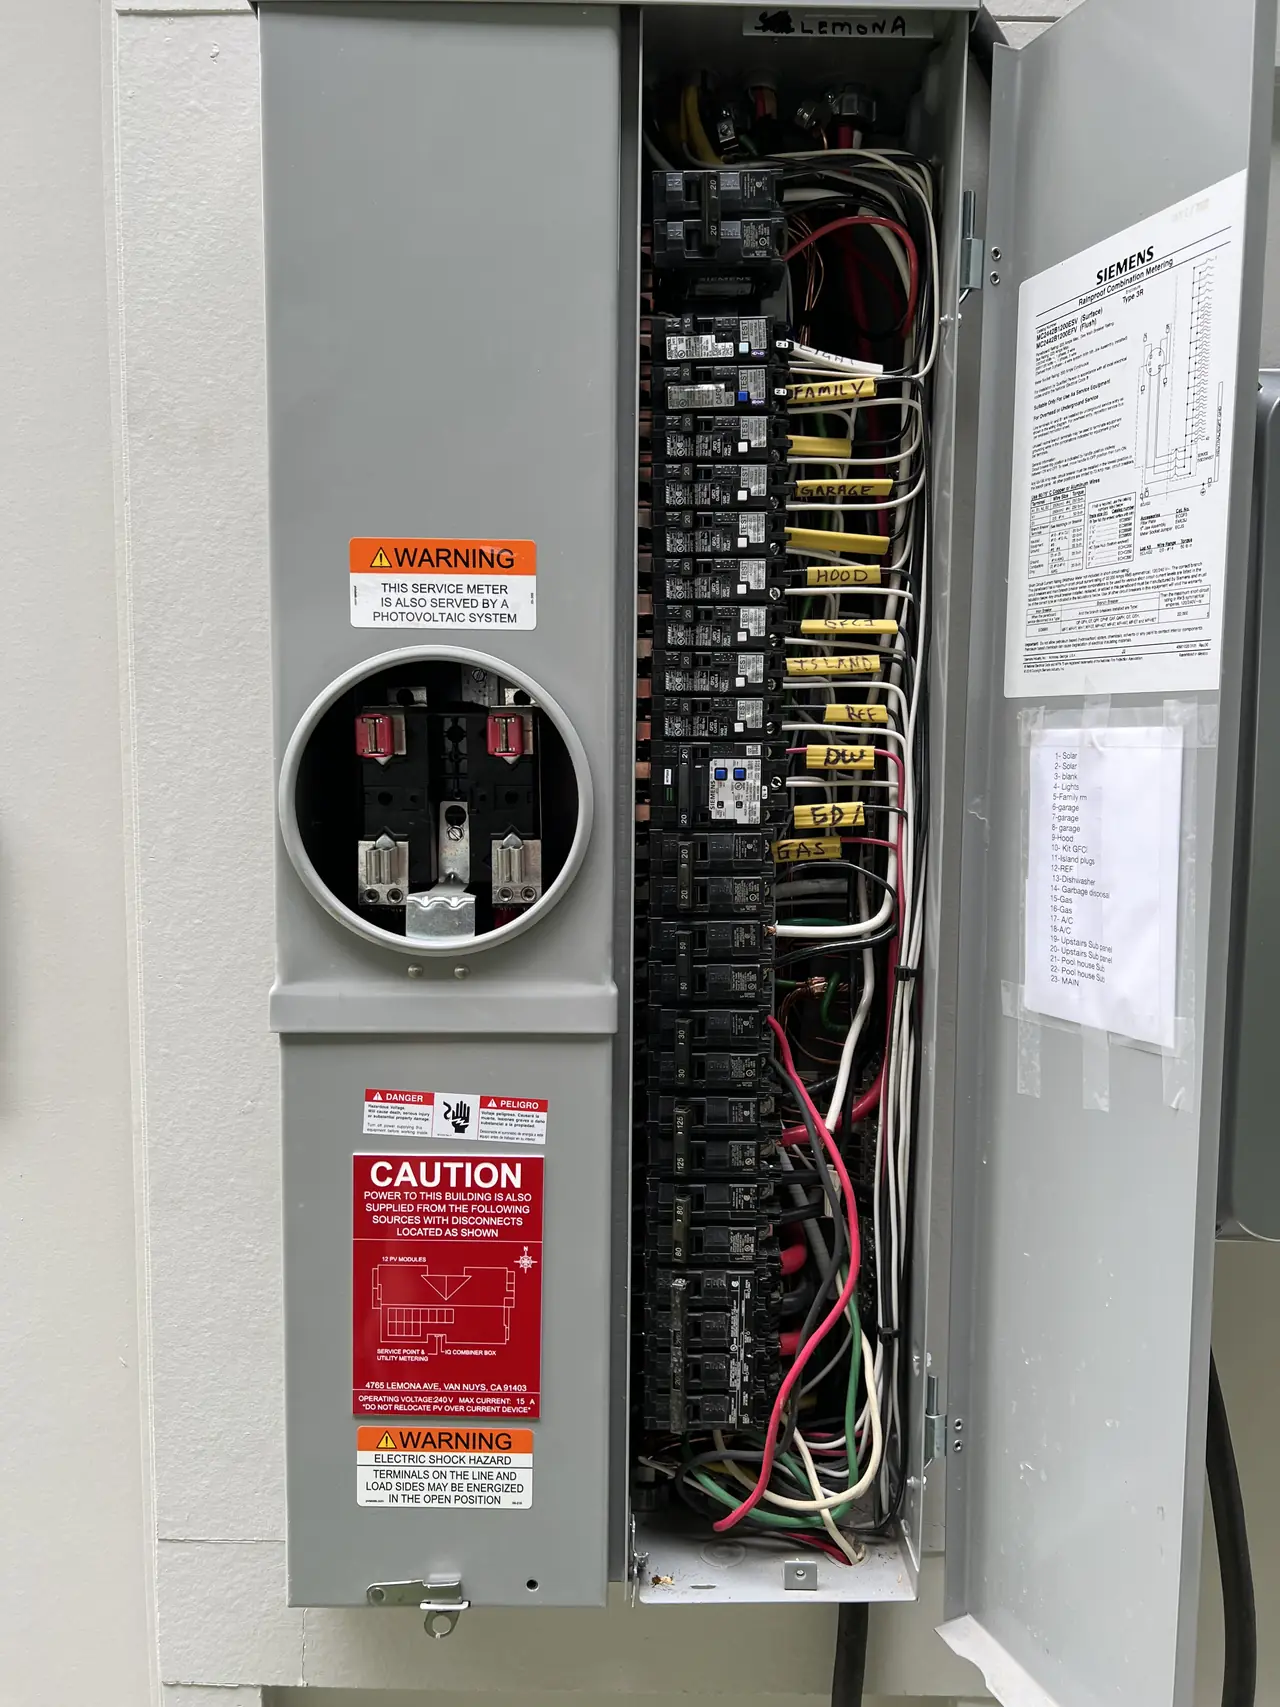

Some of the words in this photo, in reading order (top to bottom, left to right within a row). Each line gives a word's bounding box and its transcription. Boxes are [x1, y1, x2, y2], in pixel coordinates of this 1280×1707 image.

[1096, 245, 1154, 286] SIEMENS
[1078, 287, 1106, 306] Rainproof
[1106, 271, 1145, 293] Combination
[1145, 258, 1174, 276] Metering
[1122, 291, 1135, 304] Type
[793, 380, 865, 400] FAMILY
[801, 485, 875, 497] GARAGE
[394, 548, 515, 569] WARNING
[816, 569, 868, 583] HOOD
[381, 582, 408, 593] THIS
[412, 583, 463, 594] SERVICE
[467, 584, 508, 595] METER
[381, 598, 392, 608] IS
[394, 598, 427, 608] ALSO
[430, 598, 478, 608] SERVED
[482, 599, 498, 608] BY
[500, 599, 509, 608] A
[373, 612, 466, 623] PHOTOVOLTAIC
[468, 612, 517, 624] SYSTEM
[793, 657, 873, 672] ISLAND
[845, 705, 877, 722] REF
[682, 749, 688, 758] 20
[824, 747, 867, 767] DW
[1062, 752, 1078, 760] Solar
[1062, 762, 1077, 770] Solar
[1062, 783, 1080, 792] Lights
[1059, 825, 1080, 833] garage
[682, 850, 688, 860] 20
[777, 842, 826, 860] GAS
[1080, 857, 1095, 866] plugs
[1061, 885, 1088, 896] Garbage
[1060, 916, 1074, 924] A/C
[1061, 937, 1088, 947] Upstairs
[1088, 940, 1099, 950] Sub
[1061, 947, 1088, 958] Upstairs
[1088, 951, 1099, 960] Sub
[1061, 957, 1075, 966] Pool
[1077, 959, 1095, 969] house
[1096, 963, 1105, 972] Sub
[1061, 967, 1076, 976] Pool
[1077, 970, 1095, 980] house
[1096, 974, 1105, 983] Sub
[1061, 977, 1079, 986] MAIN
[386, 1093, 424, 1102] DANGER
[500, 1100, 539, 1110] PELIGRO
[370, 1161, 522, 1189] CAUTION
[364, 1191, 401, 1200] POWER
[403, 1191, 417, 1200] TO
[419, 1192, 443, 1201] THIS
[445, 1192, 492, 1201] BUILDING
[494, 1193, 504, 1202] IS
[505, 1193, 532, 1202] ALSO
[365, 1203, 414, 1212] SUPPLIED
[416, 1204, 446, 1213] FROM
[448, 1204, 469, 1213] THE
[471, 1204, 530, 1214] FOLLOWING
[372, 1215, 421, 1224] SOURCES
[423, 1216, 449, 1225] WITH
[452, 1216, 523, 1226] DISCONNECTS
[396, 1228, 442, 1237] LOCATED
[444, 1228, 458, 1237] AS
[461, 1228, 499, 1237] SHOWN
[386, 1382, 422, 1390] LEMONA
[422, 1383, 442, 1391] AVE,
[399, 1431, 512, 1450] WARNING
[374, 1453, 426, 1464] ELECTRIC
[428, 1454, 466, 1465] SHOCK
[469, 1455, 512, 1466] HAZARD
[373, 1469, 430, 1480] TERMINALS
[432, 1470, 448, 1480] ON
[449, 1470, 470, 1480] THE
[472, 1471, 494, 1480] LINE
[495, 1471, 517, 1481] AND
[366, 1481, 393, 1491] LOAD
[395, 1482, 425, 1492] SIDES
[428, 1482, 448, 1492] MAY
[450, 1483, 464, 1492] BE
[467, 1483, 524, 1493] ENERGIZED
[389, 1494, 399, 1503] IN
[401, 1494, 421, 1504] THE
[423, 1495, 451, 1504] OPEN
[454, 1495, 501, 1505] POSITION
